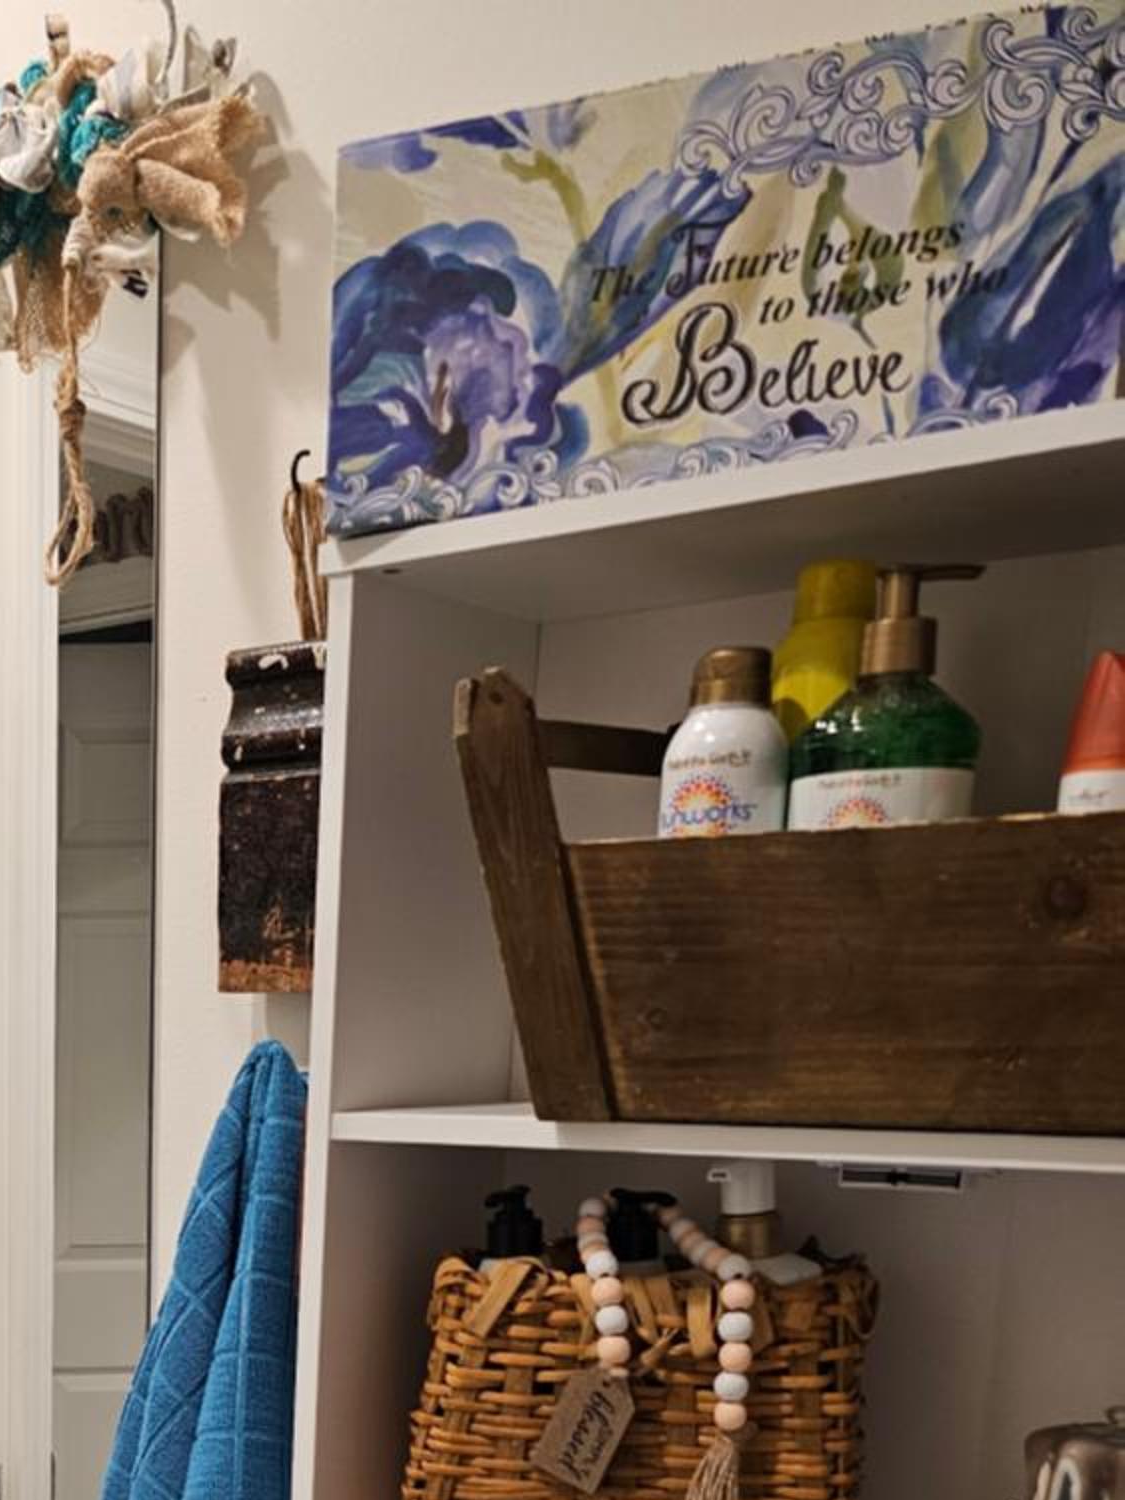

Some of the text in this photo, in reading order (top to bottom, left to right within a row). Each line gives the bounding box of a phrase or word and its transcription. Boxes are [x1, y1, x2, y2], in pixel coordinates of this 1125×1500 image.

[591, 221, 965, 302] The Future belongs
[759, 260, 1010, 325] to those who
[621, 301, 912, 426] Believe
